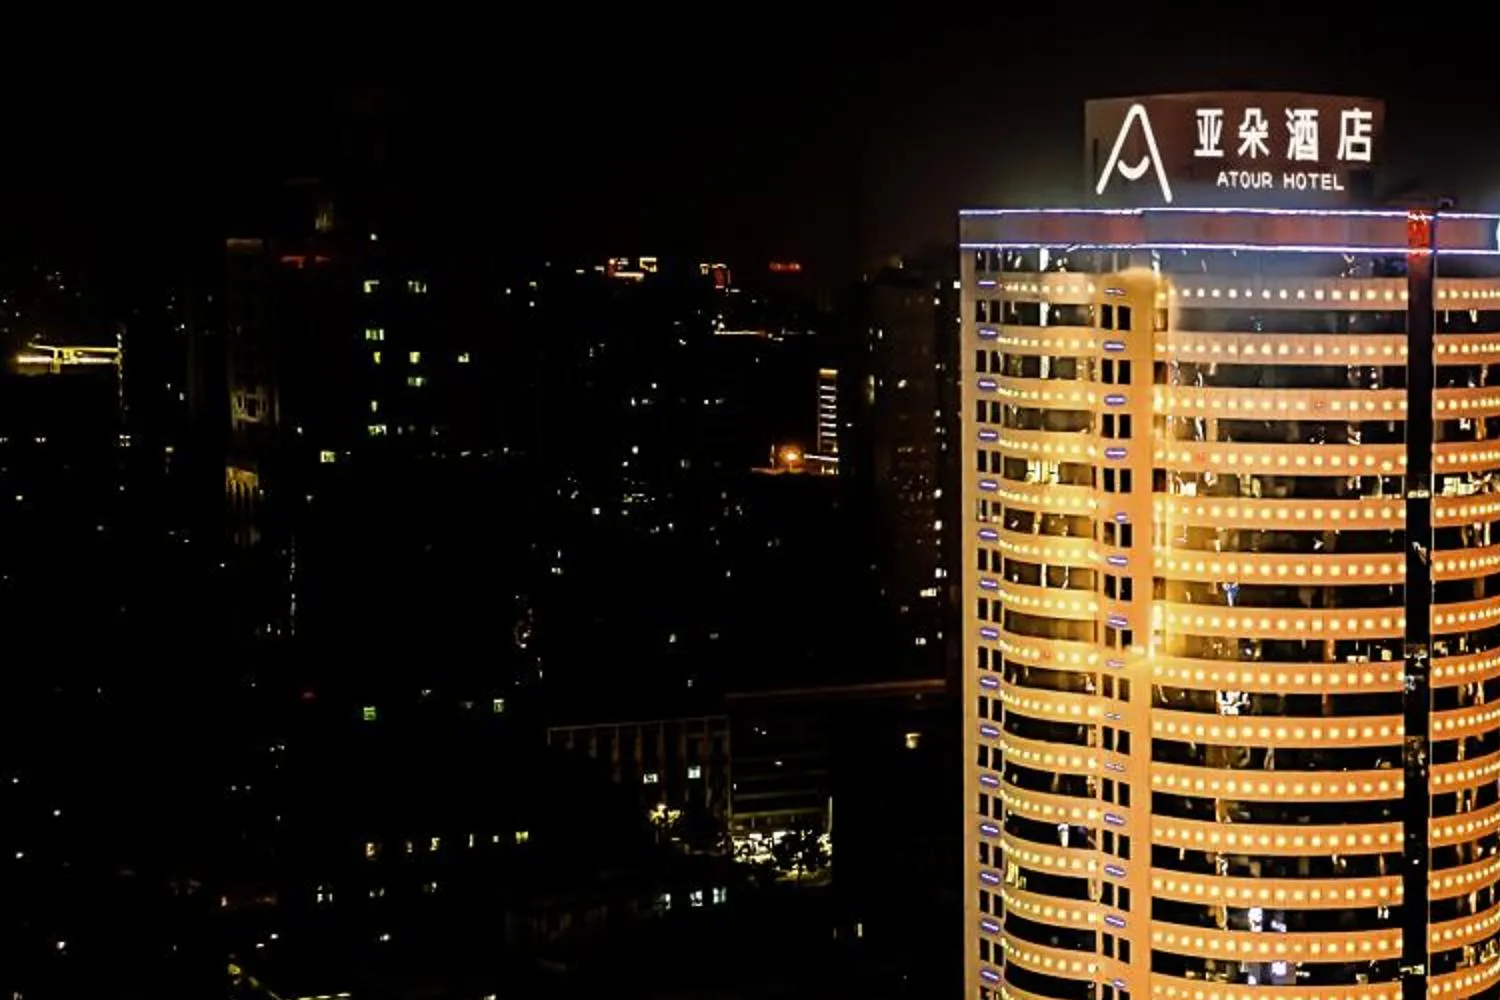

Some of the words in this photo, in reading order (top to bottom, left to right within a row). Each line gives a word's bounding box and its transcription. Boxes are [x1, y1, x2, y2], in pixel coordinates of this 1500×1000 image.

[1193, 107, 1375, 163] 亚朵酒店
[1216, 170, 1273, 190] ATOUR
[1283, 172, 1345, 191] HOTEL
